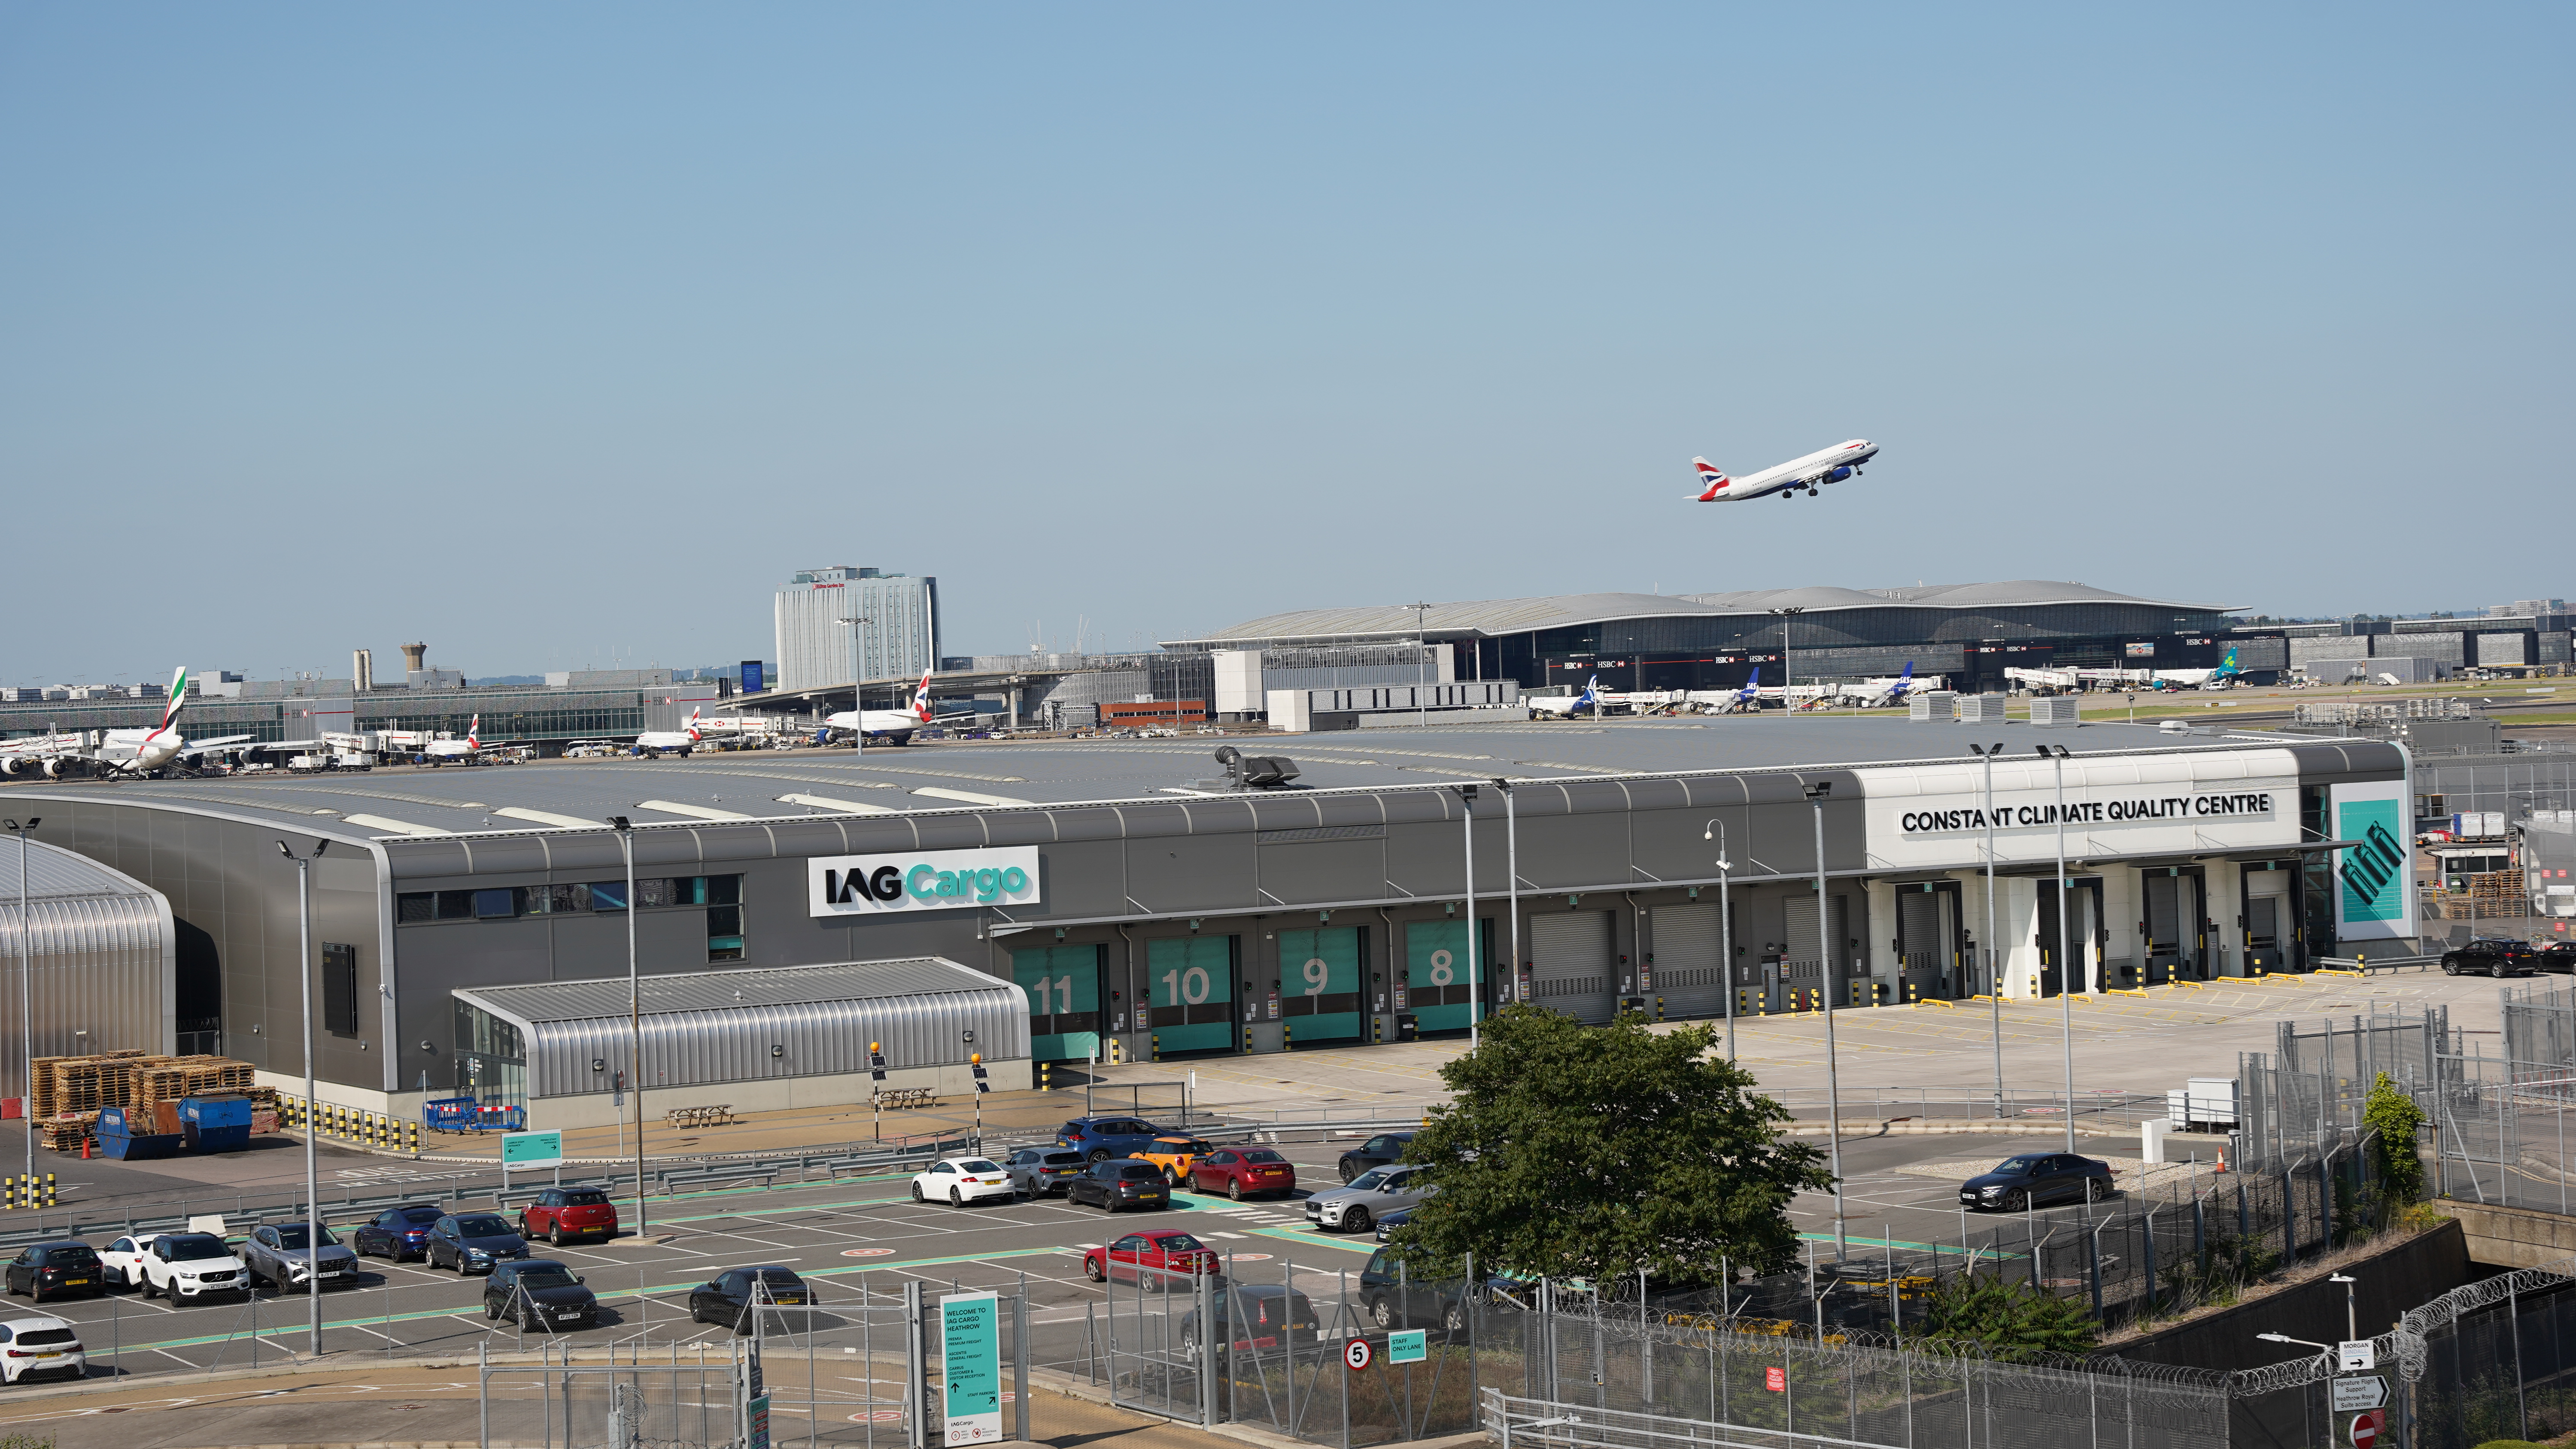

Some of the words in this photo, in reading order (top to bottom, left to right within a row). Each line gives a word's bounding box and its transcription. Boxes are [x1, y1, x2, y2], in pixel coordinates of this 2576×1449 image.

[1825, 457, 1841, 465] BRITISH
[1597, 660, 1616, 668] HSBC
[292, 709, 302, 718] HSBC
[653, 697, 665, 706] HSBC
[1902, 807, 2013, 831] CONSTANT
[2018, 802, 2102, 825] CLIMATE
[2108, 797, 2190, 820] QUALITY
[2196, 794, 2269, 815] CENTRE
[905, 864, 1027, 901] Cargo
[1303, 958, 1328, 996] 9
[1430, 949, 1453, 986] 8
[1034, 975, 1071, 1015] 11
[1162, 967, 1209, 1005] 10
[947, 1323, 980, 1332] HEATHROW
[1353, 1346, 1363, 1363] 5
